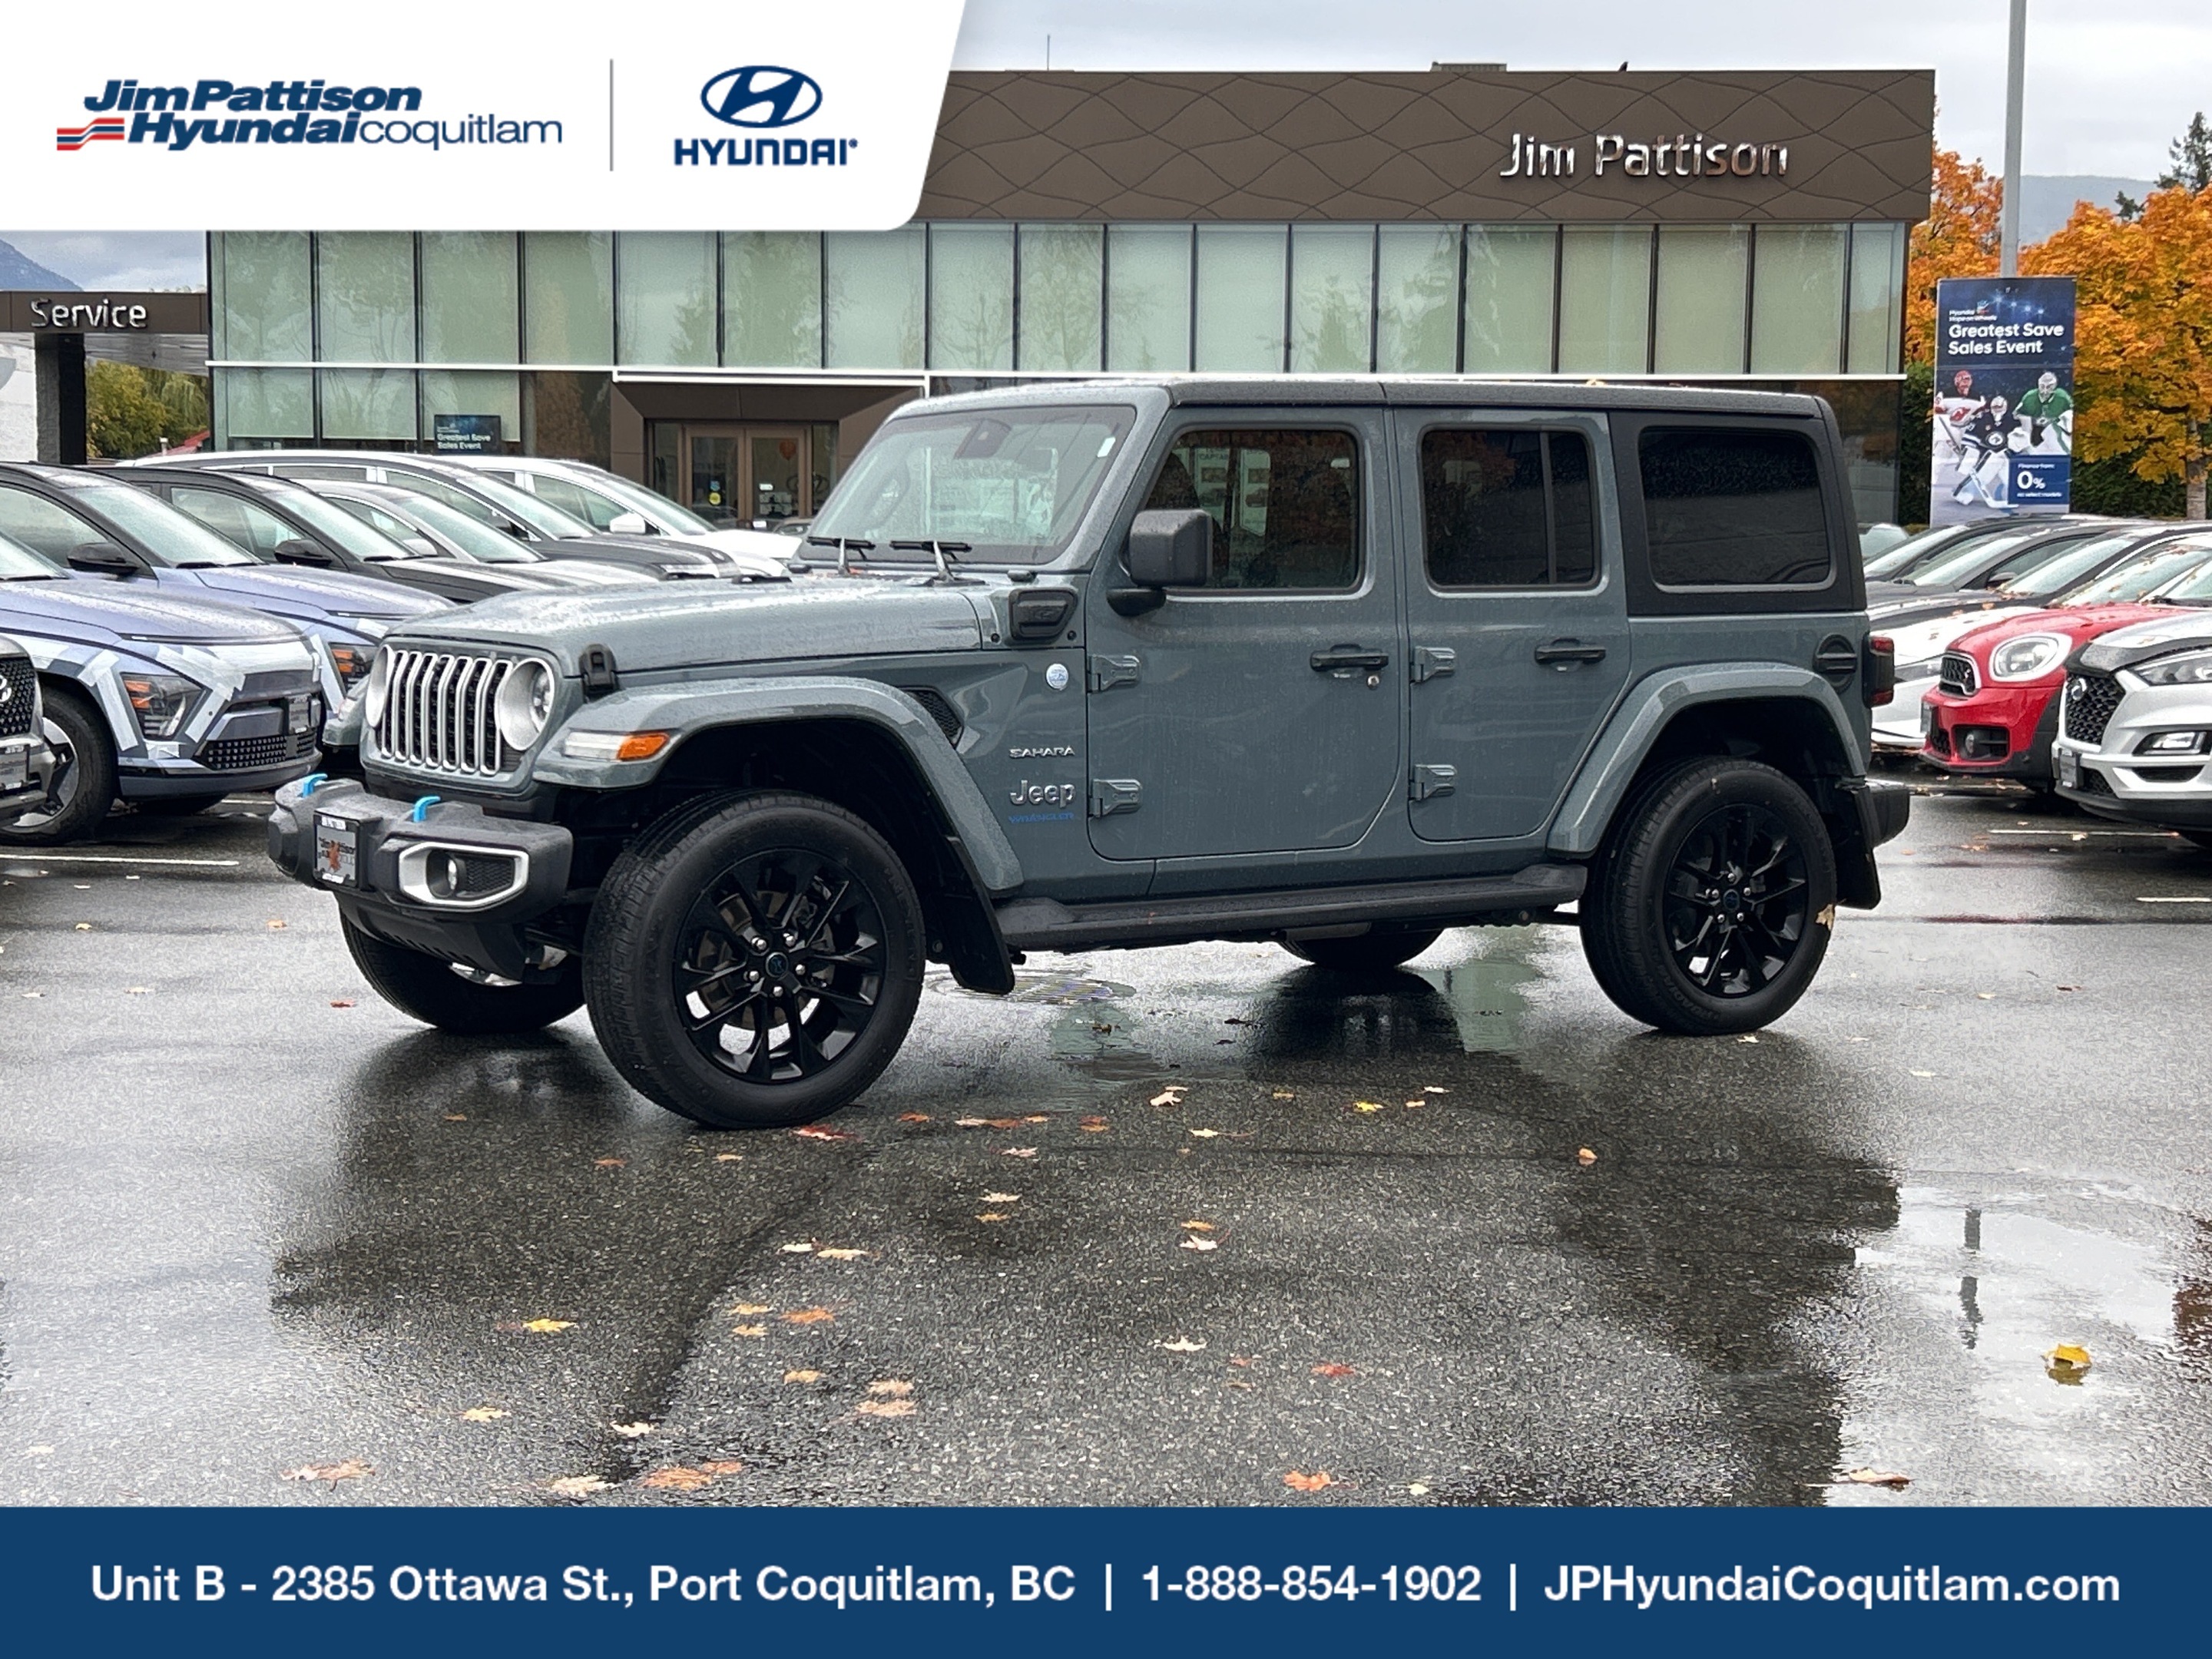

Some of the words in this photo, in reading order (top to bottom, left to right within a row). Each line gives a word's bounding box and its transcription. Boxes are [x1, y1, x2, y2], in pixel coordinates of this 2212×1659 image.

[1500, 134, 1575, 177] Jim
[1594, 134, 1787, 177] Pattison
[31, 298, 147, 328] Service
[1949, 323, 2020, 338] Greatest
[2022, 322, 2065, 336] Save
[1948, 340, 1993, 355] Sales
[1995, 339, 2043, 354] Event
[2017, 470, 2046, 490] 0%
[1009, 746, 1075, 759] SAHARA
[1009, 780, 1075, 808] Jeep
